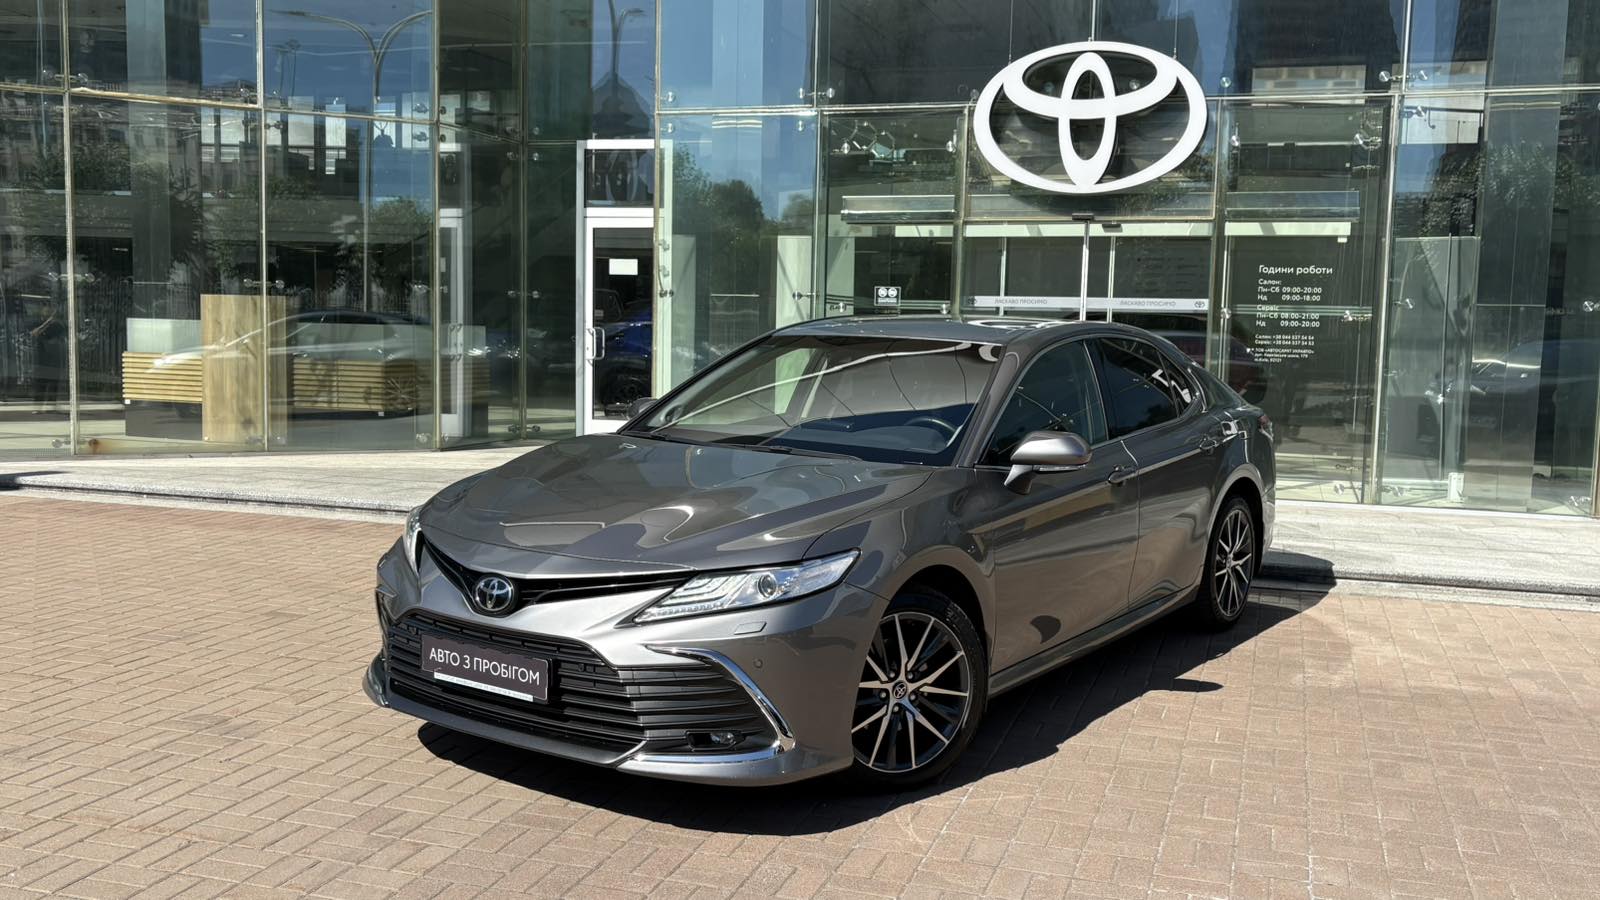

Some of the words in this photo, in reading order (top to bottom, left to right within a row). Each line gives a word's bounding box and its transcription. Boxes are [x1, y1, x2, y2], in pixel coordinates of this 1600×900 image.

[1259, 265, 1294, 275] Години
[1296, 265, 1333, 275] роботи
[429, 647, 460, 666] АВТО
[473, 657, 540, 685] ПРОБІГОМ
